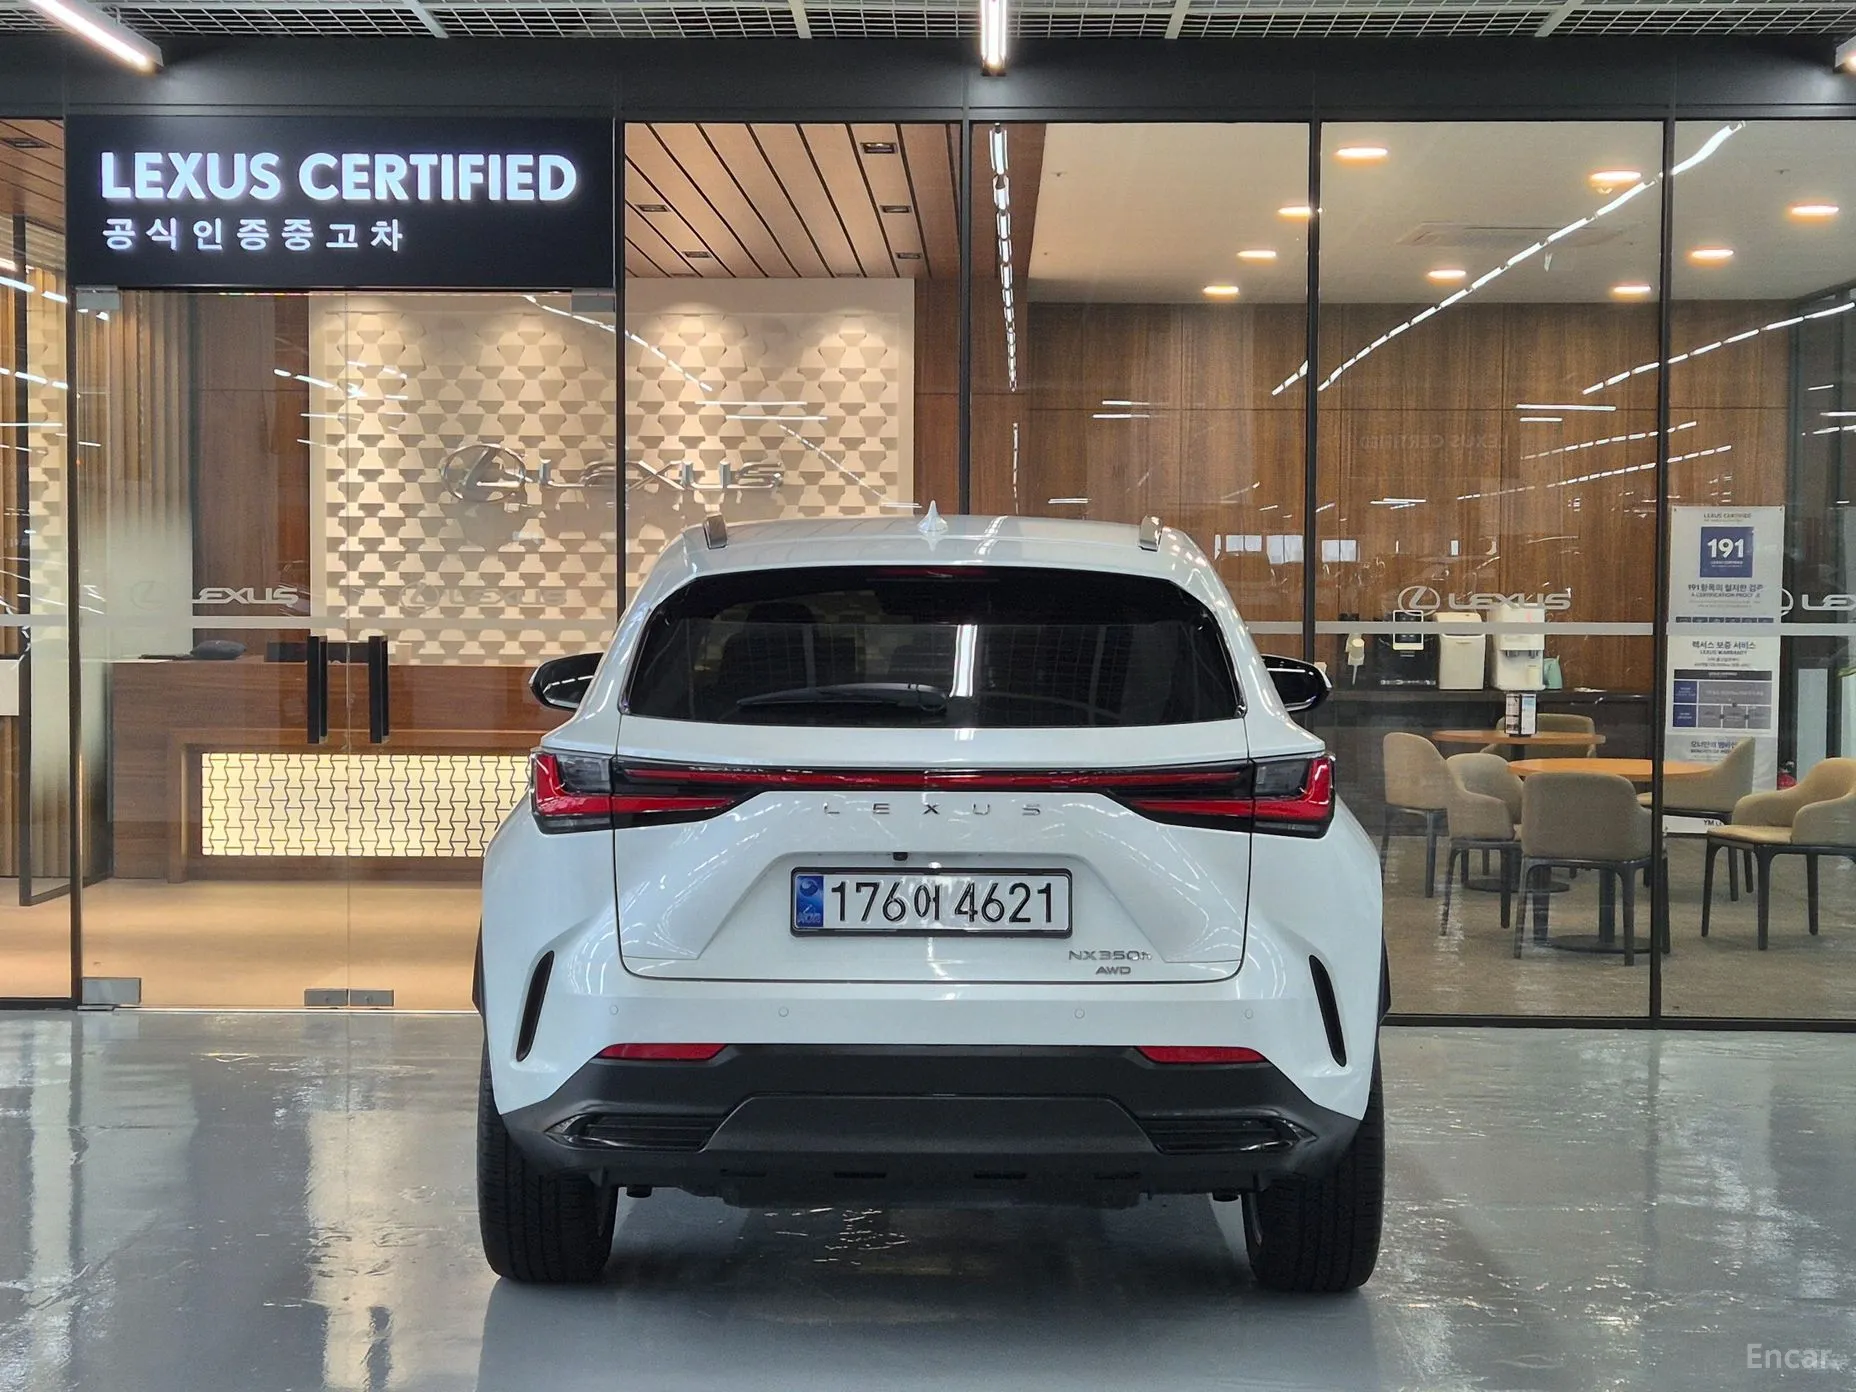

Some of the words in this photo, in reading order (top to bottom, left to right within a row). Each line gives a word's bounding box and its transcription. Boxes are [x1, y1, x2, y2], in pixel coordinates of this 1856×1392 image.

[101, 152, 281, 200] LEXUS
[298, 153, 577, 201] CERTIFIED
[538, 459, 784, 491] LEXUS
[1707, 538, 1744, 558] 191
[192, 587, 300, 606] EXUS
[1449, 593, 1572, 610] LEXUS
[1733, 641, 1756, 650] 서비스
[823, 803, 1042, 815] LEXUS
[830, 881, 941, 923] 176어
[954, 881, 1053, 923] 4621
[1095, 966, 1132, 975] AWD
